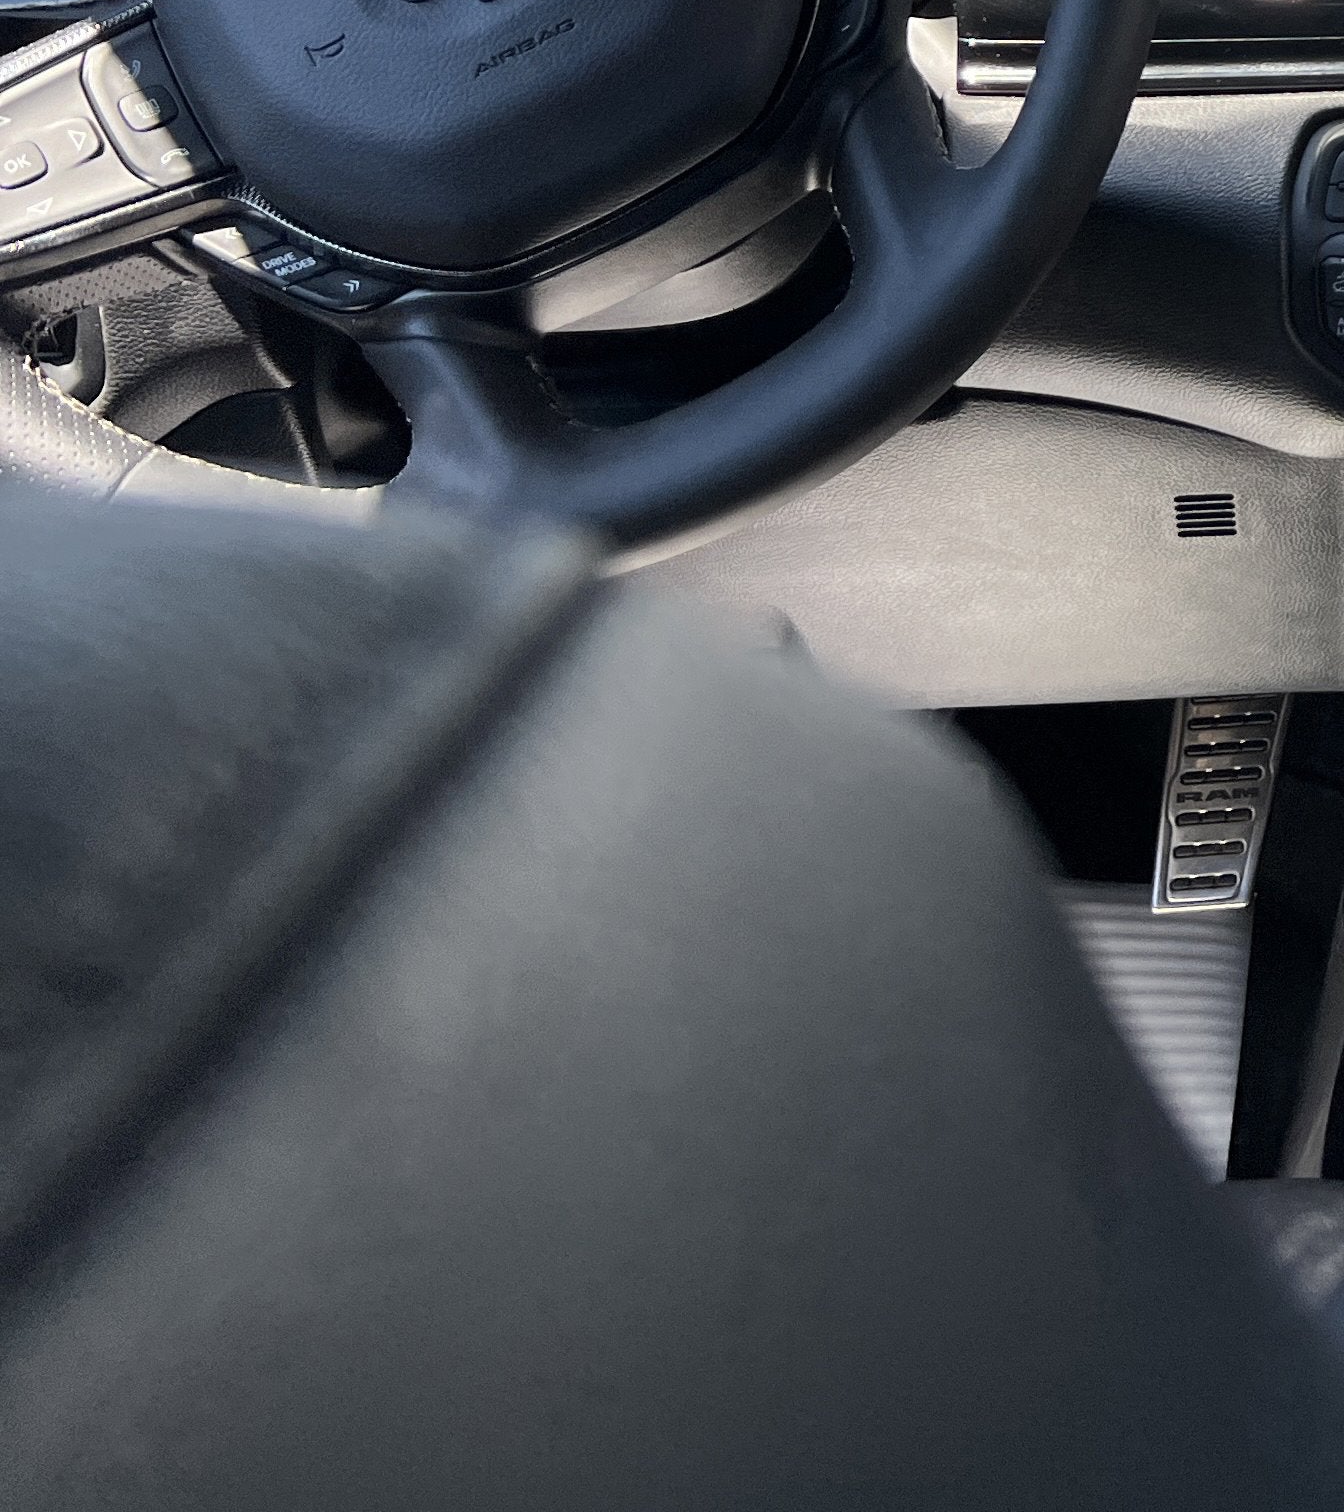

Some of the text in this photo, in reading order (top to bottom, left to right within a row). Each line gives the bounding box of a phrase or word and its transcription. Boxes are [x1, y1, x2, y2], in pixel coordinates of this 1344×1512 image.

[475, 17, 576, 79] AIRBAG
[3, 154, 32, 174] OK
[262, 251, 297, 270] DRIVE
[275, 256, 316, 277] MODES
[1176, 788, 1260, 803] RAM
